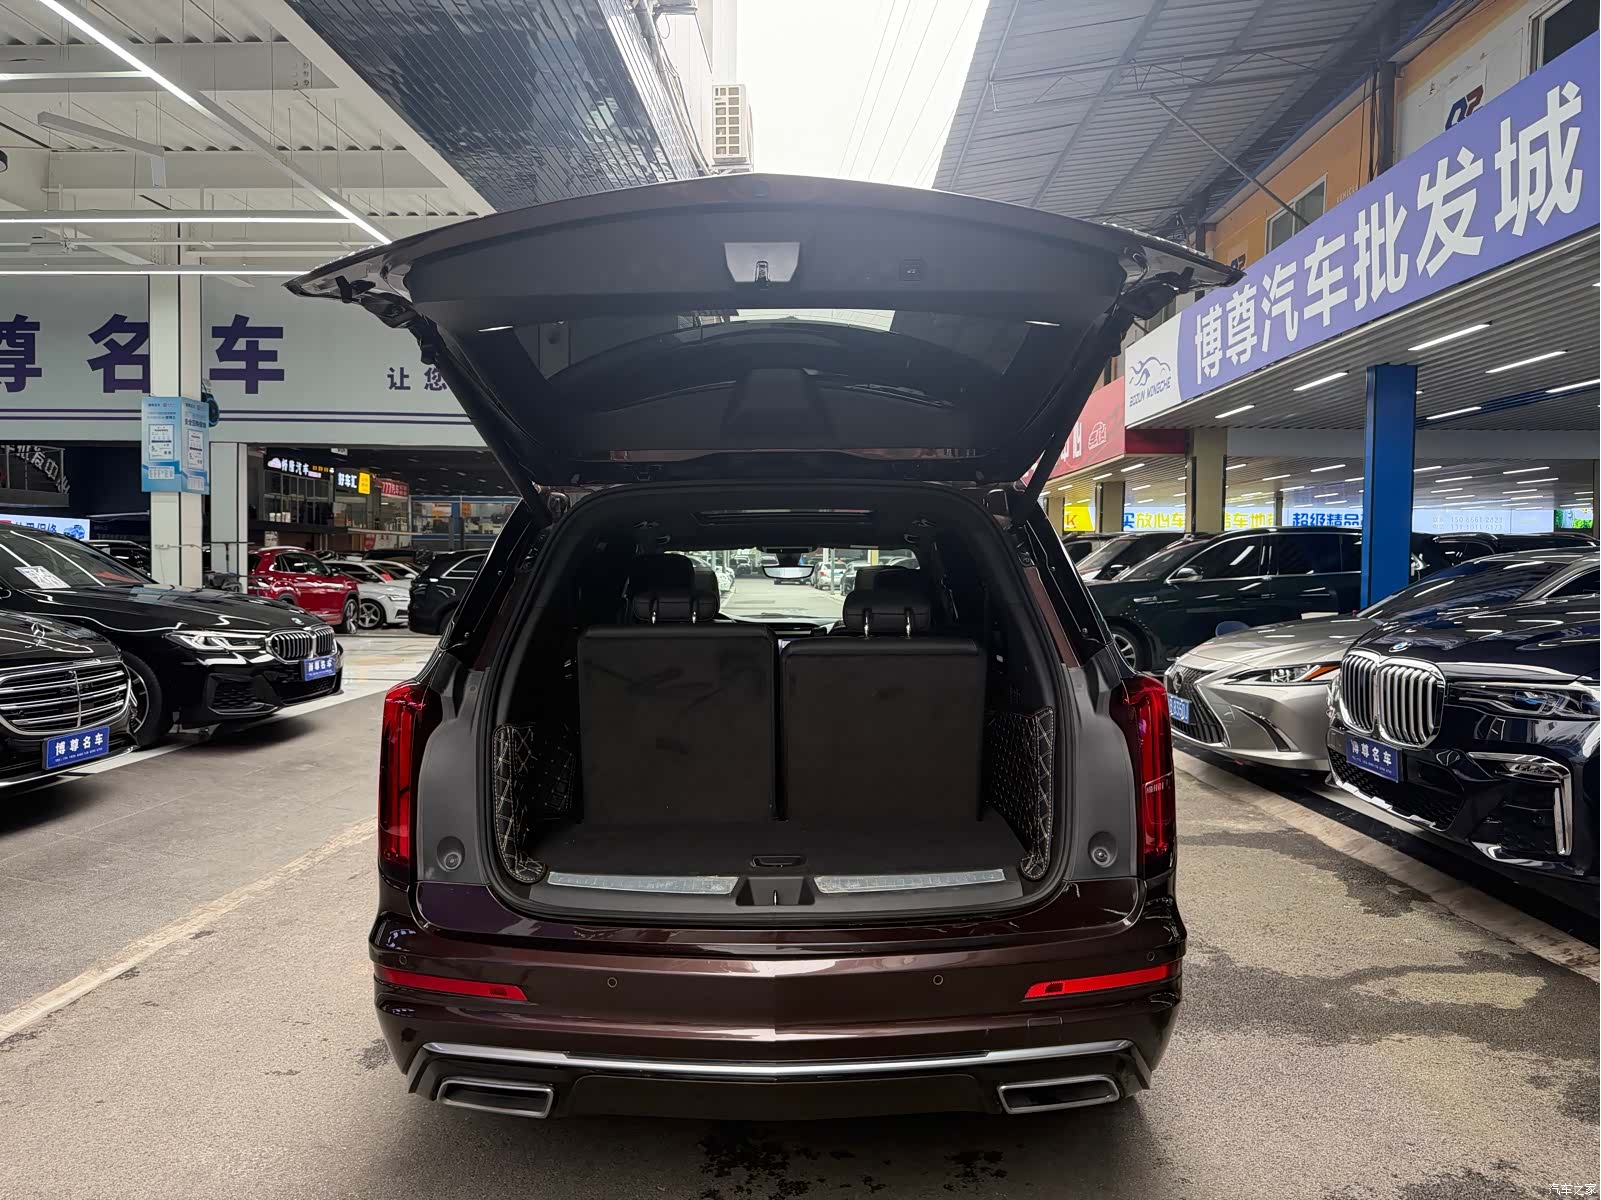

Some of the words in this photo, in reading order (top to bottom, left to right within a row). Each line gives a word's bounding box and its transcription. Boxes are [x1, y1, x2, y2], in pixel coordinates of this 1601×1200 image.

[1194, 80, 1583, 385] 博尊汽车批发城
[387, 366, 448, 391] 让您
[1292, 512, 1363, 527] 超级精品
[55, 732, 104, 756] 博尊名车
[1350, 739, 1393, 767] 博尊名车
